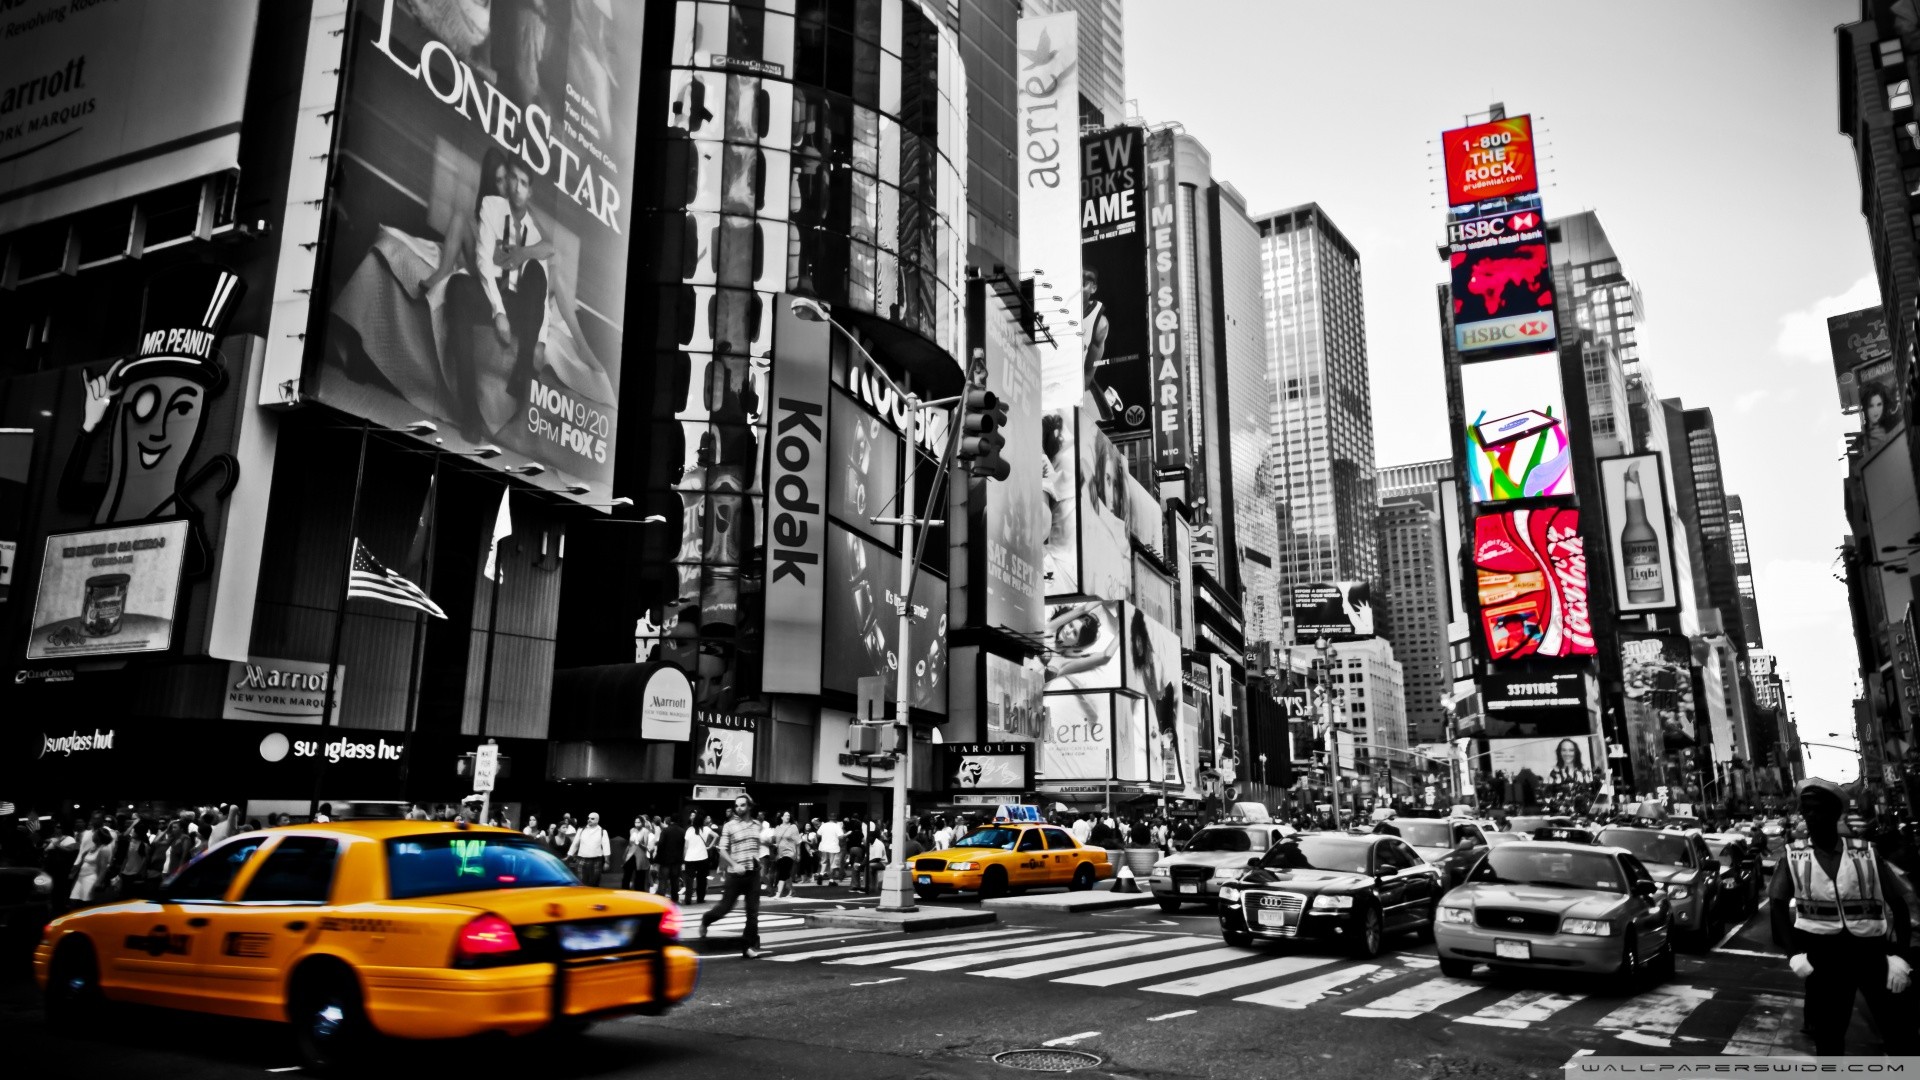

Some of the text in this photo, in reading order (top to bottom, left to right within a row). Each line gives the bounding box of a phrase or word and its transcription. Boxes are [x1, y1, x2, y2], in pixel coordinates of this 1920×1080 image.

[27, 98, 96, 133] MARQUIS
[1026, 74, 1060, 189] aerie
[1463, 132, 1511, 152] 1-800
[1470, 148, 1507, 166] THE
[1465, 161, 1516, 182] ROCK
[1463, 174, 1524, 192] prudential.com
[1147, 159, 1174, 273] TIMES
[1449, 218, 1505, 242] HSBC
[140, 328, 215, 359] MR. PEANUT
[1462, 323, 1516, 345] HSBC
[1155, 286, 1179, 433] SQUARE
[530, 378, 609, 438] MON 9/20
[528, 406, 608, 464] 9PM FOX 5
[1162, 448, 1179, 456] NYC
[773, 397, 823, 587] Kodak
[1630, 567, 1658, 581] Light
[235, 664, 339, 693] Marriot
[229, 692, 337, 709] NEW YORK MARQUS
[649, 696, 687, 709] Marriott
[697, 711, 755, 729] MARQUIS
[45, 728, 115, 758] sunglass hut
[949, 743, 1026, 754] MARQUIS
[1791, 852, 1812, 860] NYP
